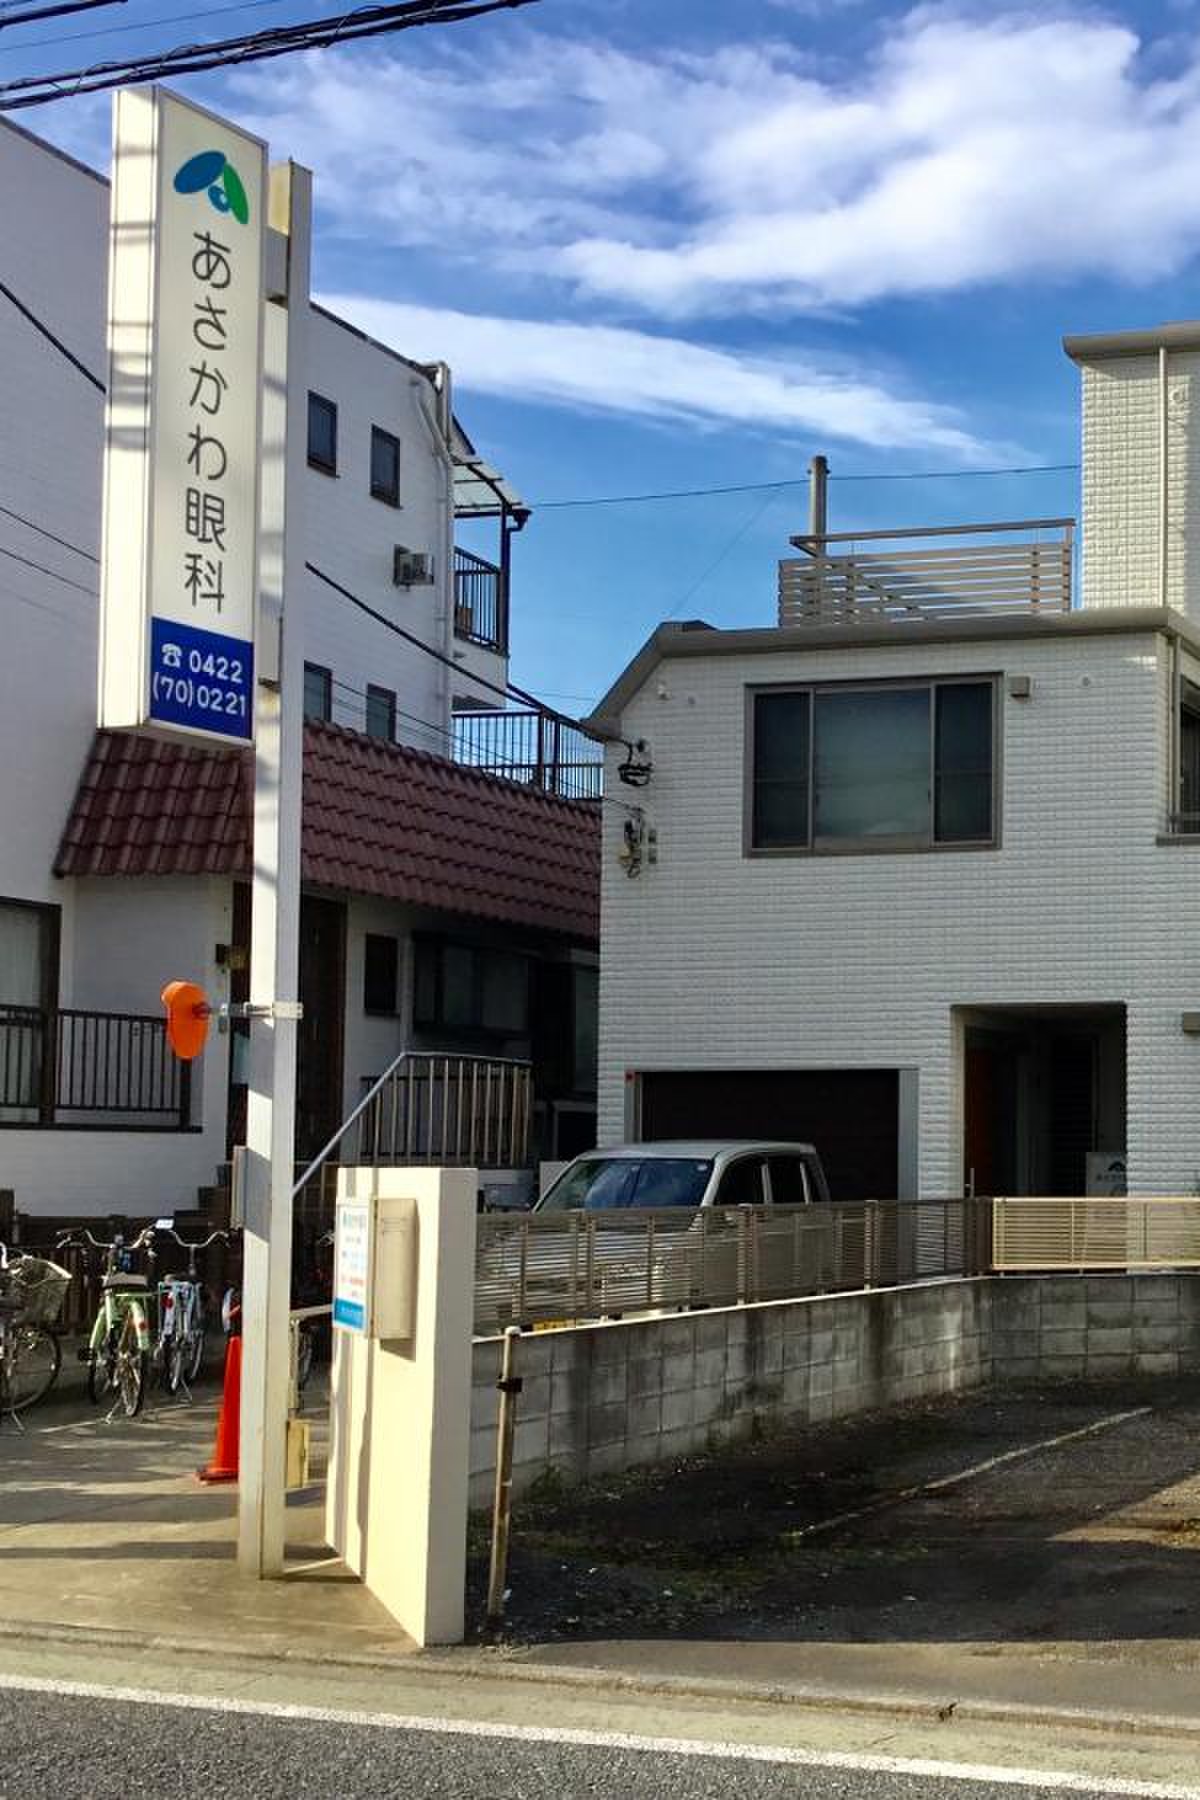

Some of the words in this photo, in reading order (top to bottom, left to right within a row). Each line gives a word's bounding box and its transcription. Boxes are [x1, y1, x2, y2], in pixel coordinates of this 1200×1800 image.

[185, 231, 231, 614] あさかわ眼科
[189, 650, 243, 684] 0422
[152, 671, 246, 717] (70)0221
